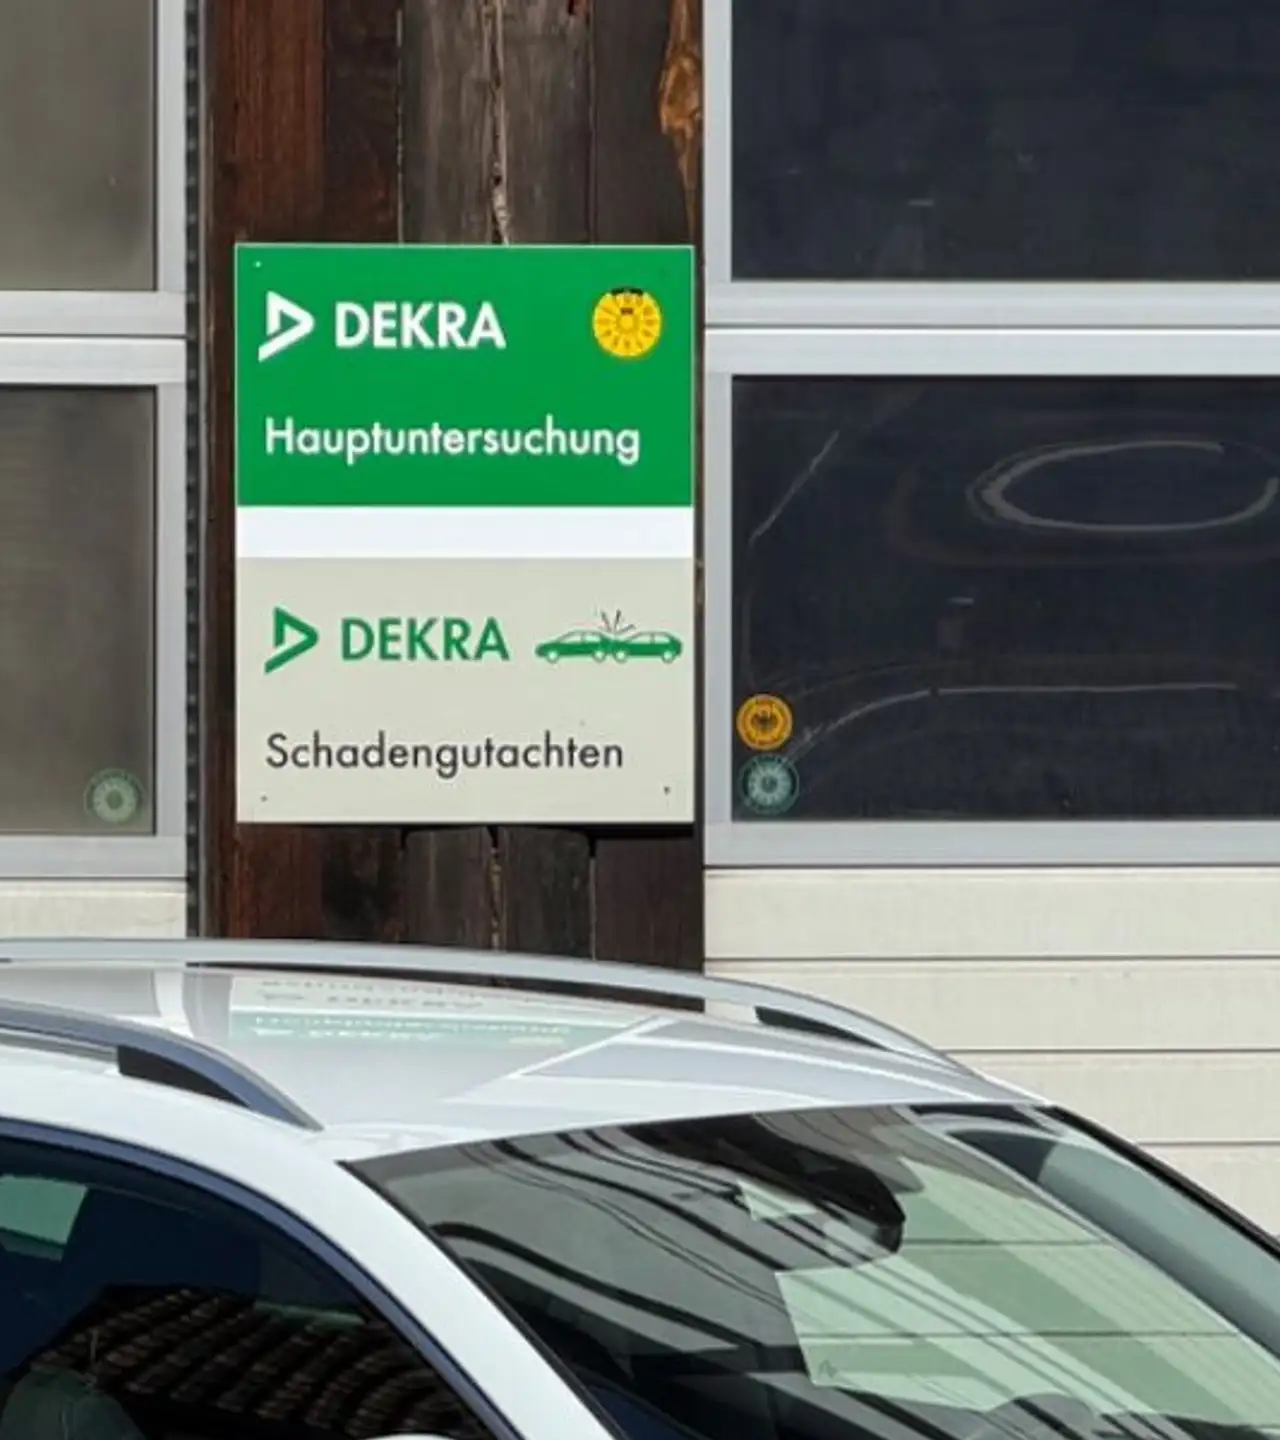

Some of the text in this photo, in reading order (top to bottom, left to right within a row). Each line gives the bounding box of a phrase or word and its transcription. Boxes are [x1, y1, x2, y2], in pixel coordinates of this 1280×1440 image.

[335, 301, 506, 349] DEKRA
[265, 414, 641, 466] Hauptuntersuchung
[340, 616, 511, 662] DEKRA
[265, 730, 624, 780] Schadengutachten
